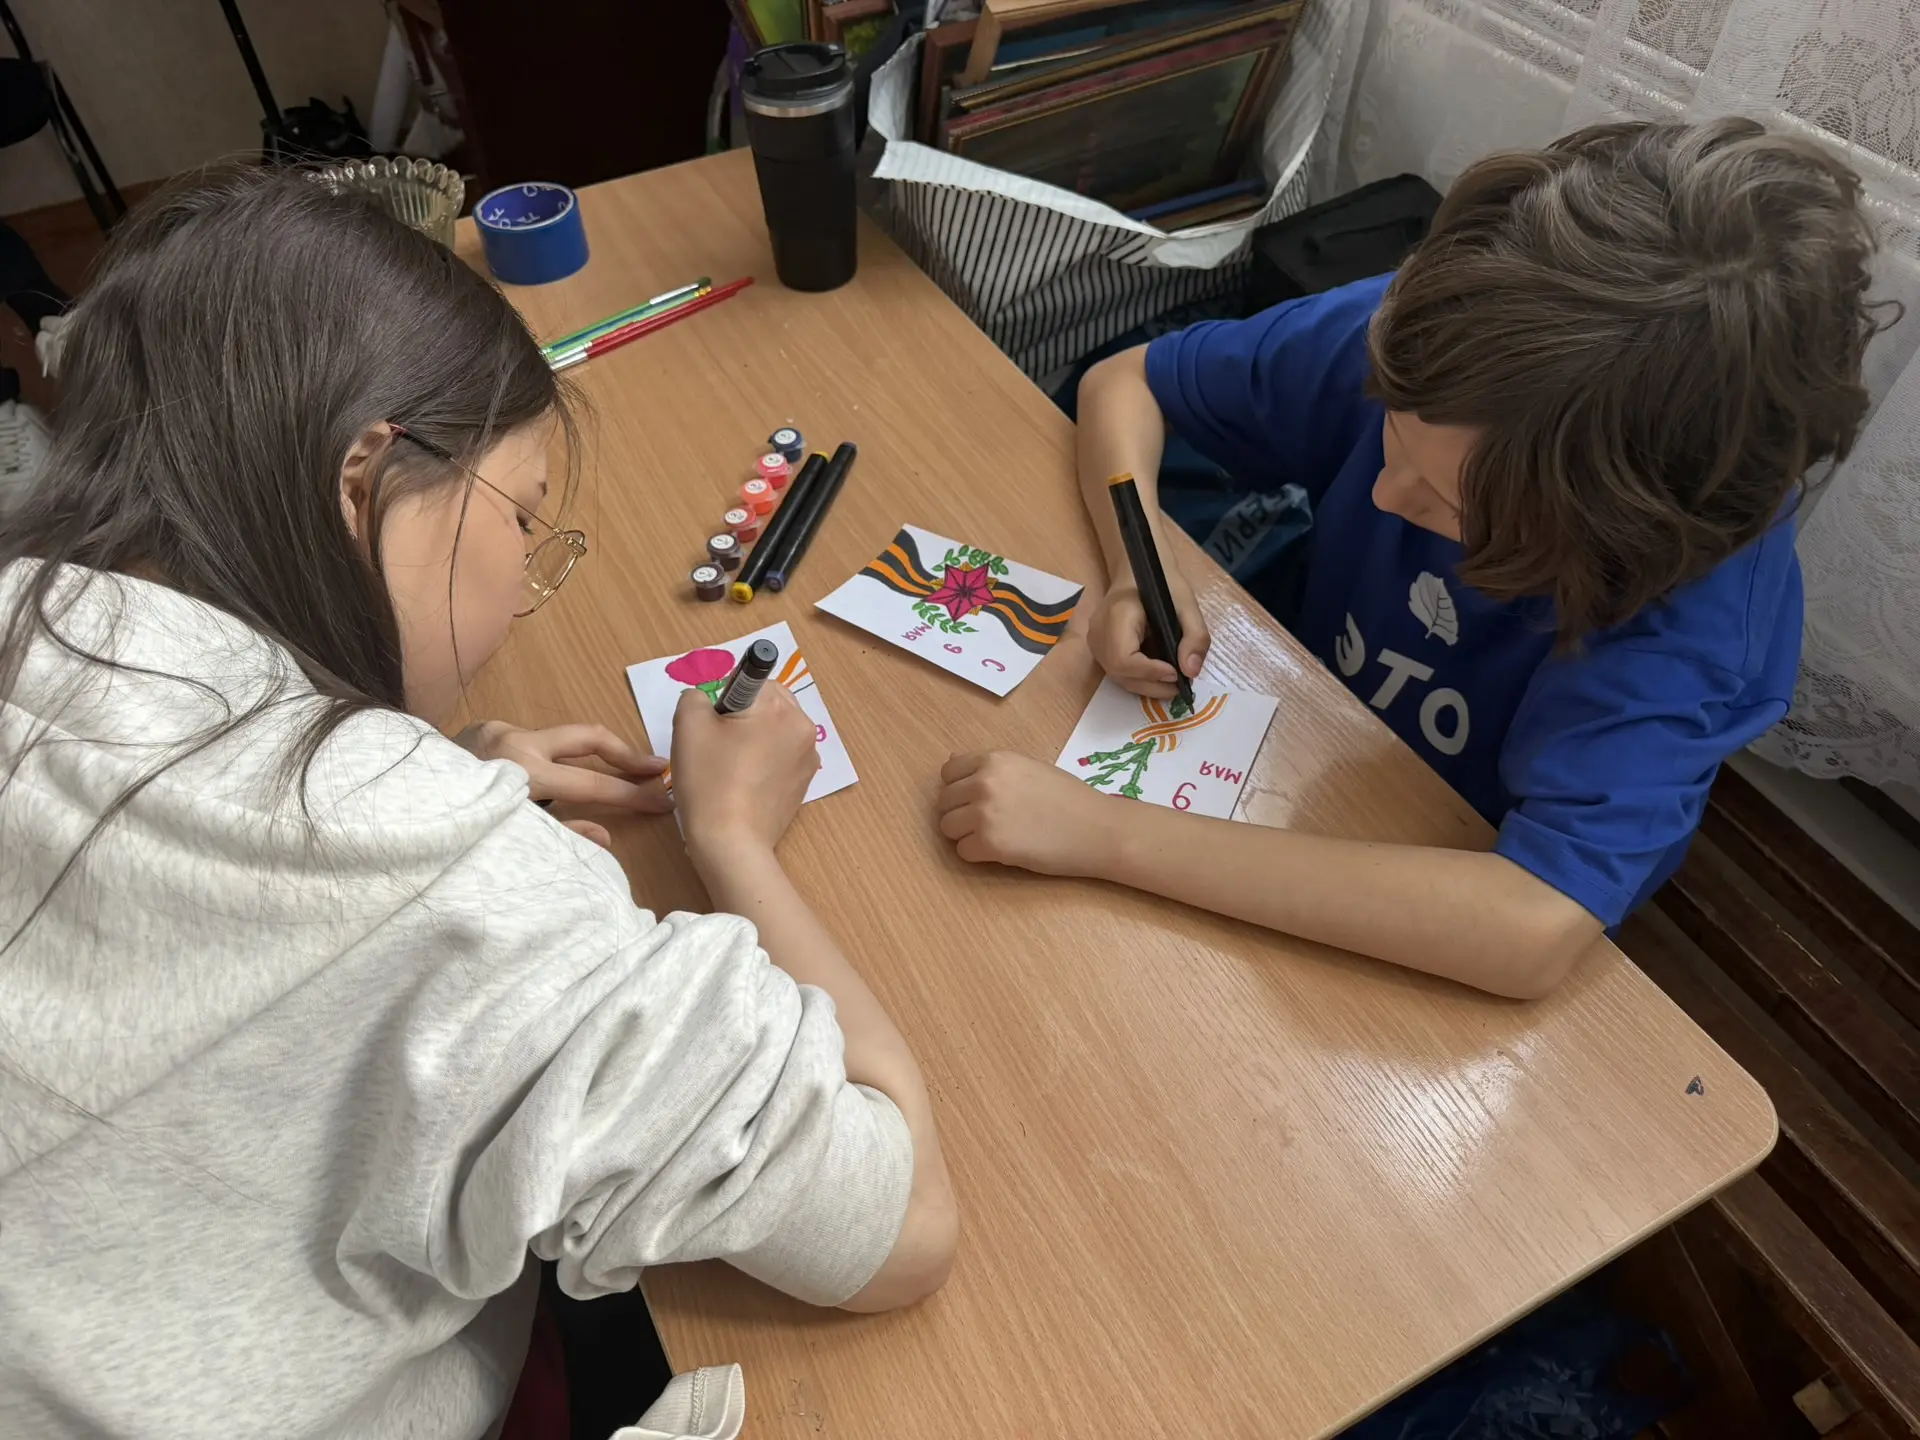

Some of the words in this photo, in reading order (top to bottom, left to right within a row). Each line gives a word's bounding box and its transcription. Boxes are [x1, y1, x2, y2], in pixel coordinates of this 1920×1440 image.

[943, 643, 963, 654] 9
[1199, 760, 1243, 785] МАЯ
[1172, 782, 1197, 811] 9
